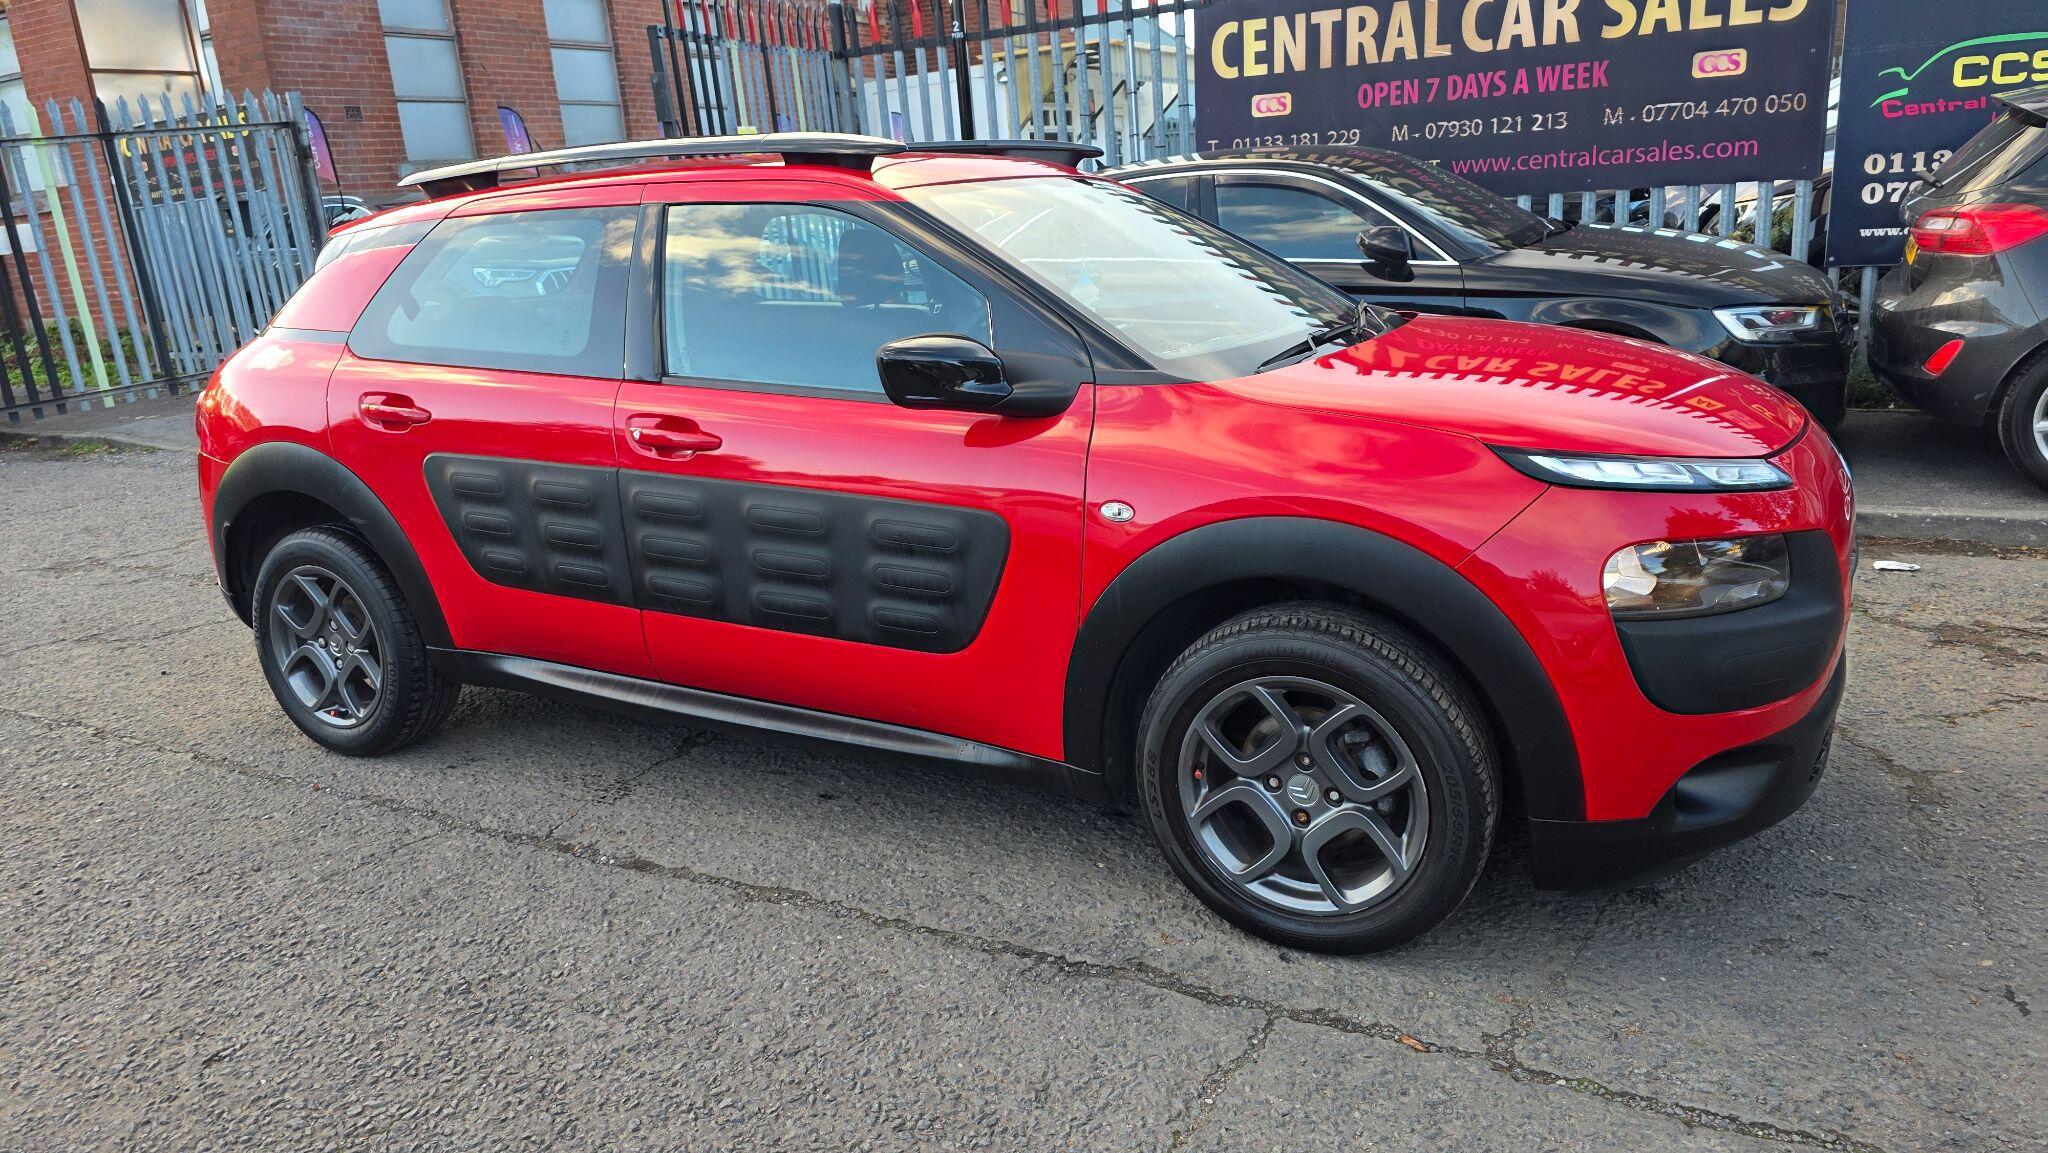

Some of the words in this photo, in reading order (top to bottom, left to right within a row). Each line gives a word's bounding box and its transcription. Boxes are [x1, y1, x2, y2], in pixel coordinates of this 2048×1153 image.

[1211, 0, 1453, 80] CENTRAL
[1461, 0, 1581, 53] CAR
[1697, 52, 1741, 75] CCS
[1357, 78, 1419, 109] OPEN
[1426, 77, 1441, 103] 7
[1446, 70, 1507, 101] DAYS
[1512, 68, 1529, 95] A
[1536, 60, 1610, 93] WEEK
[1255, 95, 1288, 114] CCS
[1603, 106, 1625, 125] M
[1643, 101, 1709, 123] 07704
[1714, 96, 1758, 117] 470
[1765, 92, 1808, 114] 050
[1881, 96, 1987, 119] Central
[1391, 124, 1409, 142] M
[1425, 118, 1483, 141] 07930
[1490, 116, 1523, 134] 121
[1531, 111, 1569, 132] 213
[1451, 139, 1759, 175] www.centralcarsales.com
